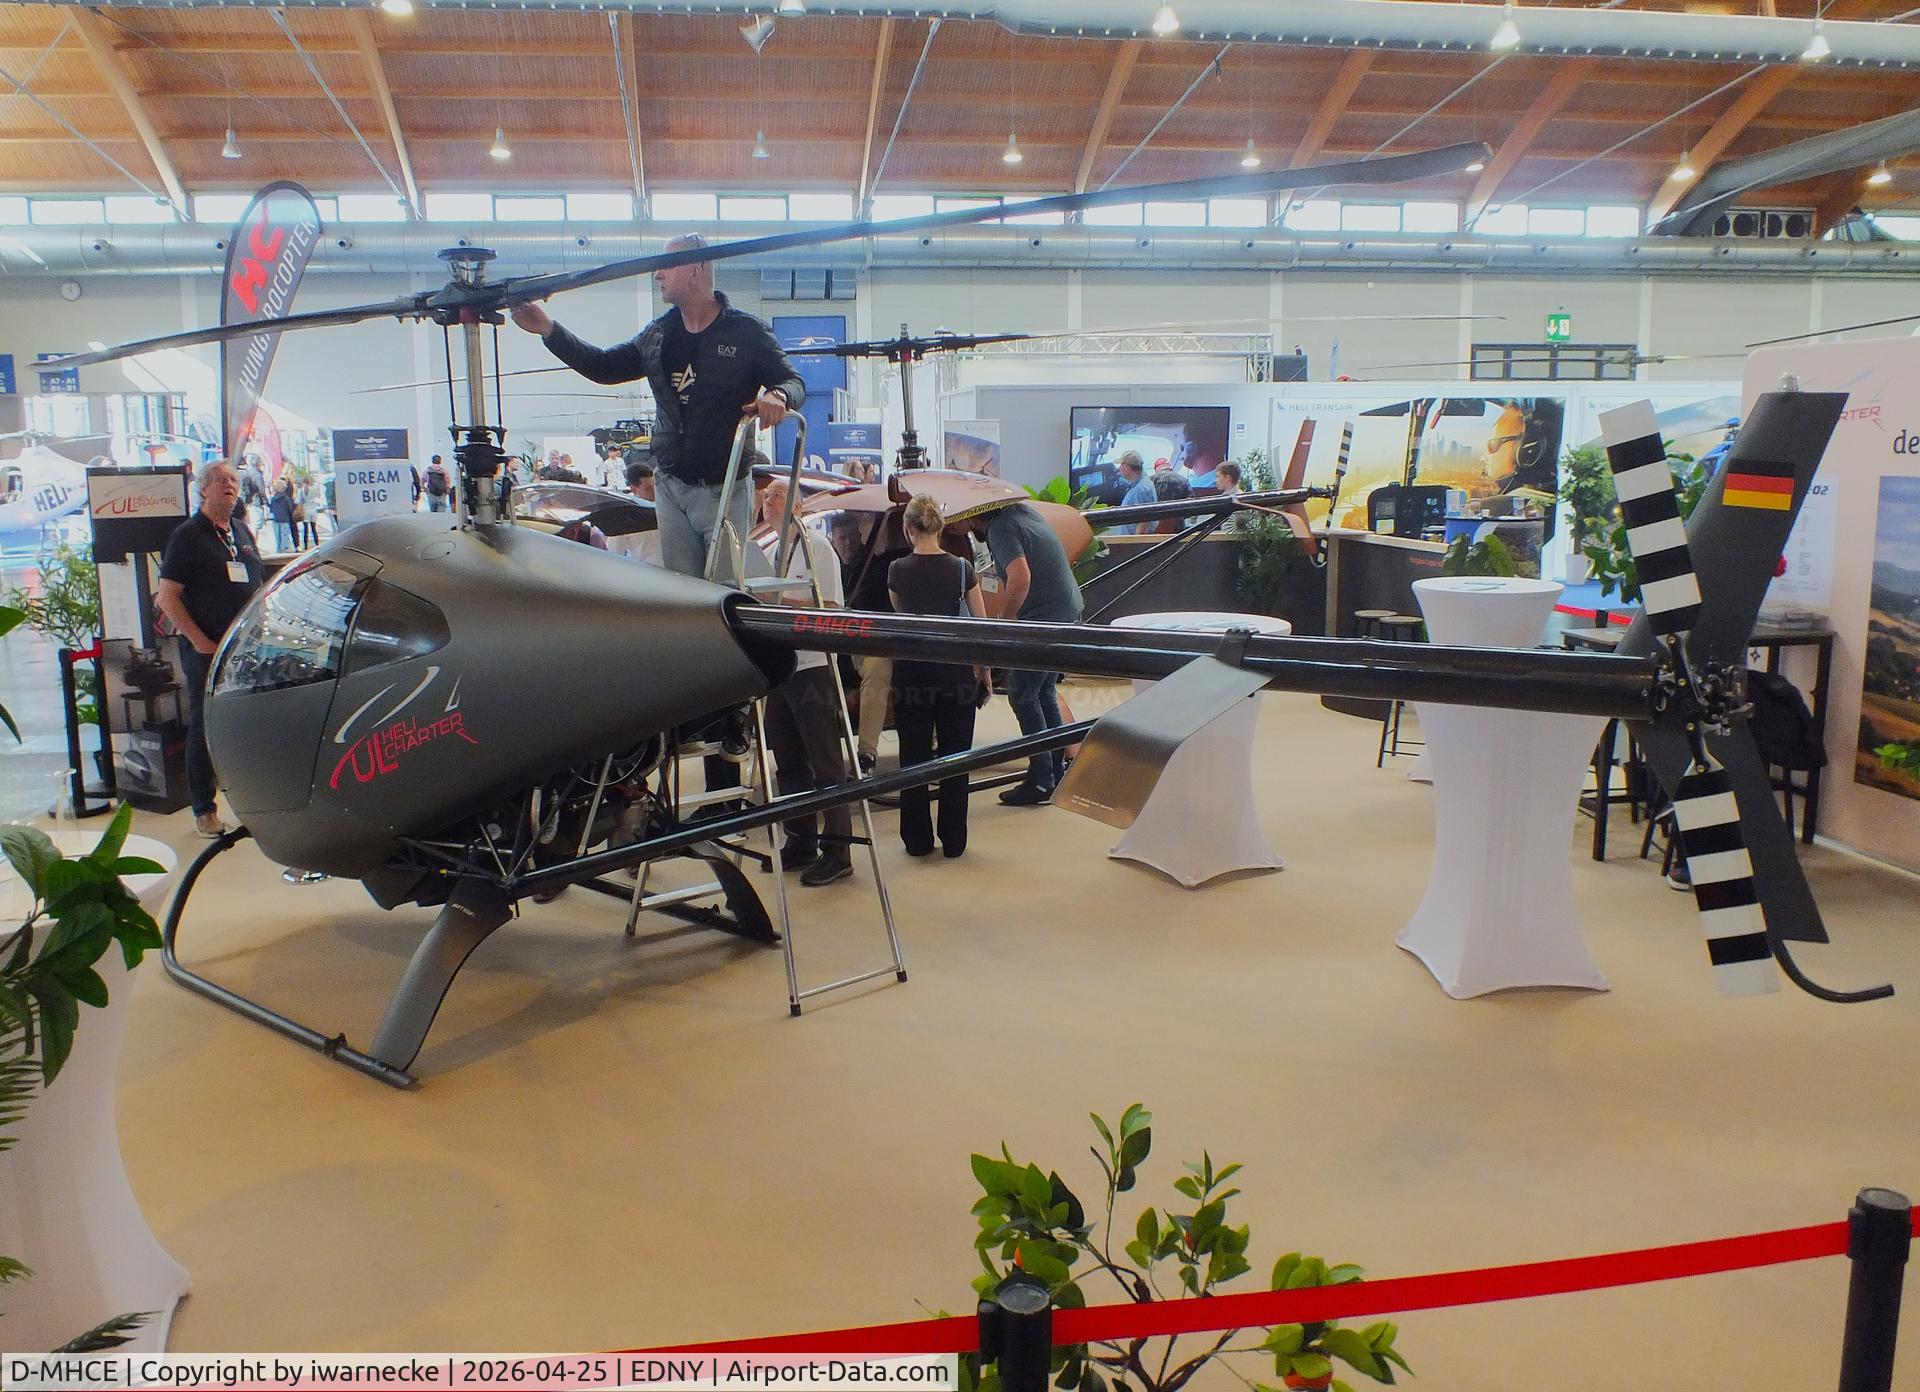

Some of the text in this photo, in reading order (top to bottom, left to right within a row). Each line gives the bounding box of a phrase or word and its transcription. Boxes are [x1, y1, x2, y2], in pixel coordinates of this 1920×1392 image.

[238, 217, 317, 396] HUNGROCOPTER
[717, 344, 737, 355] EA7
[347, 470, 400, 485] DREAM
[362, 489, 388, 503] BIG
[382, 716, 418, 745] HELI
[385, 712, 469, 759] CHARTER
